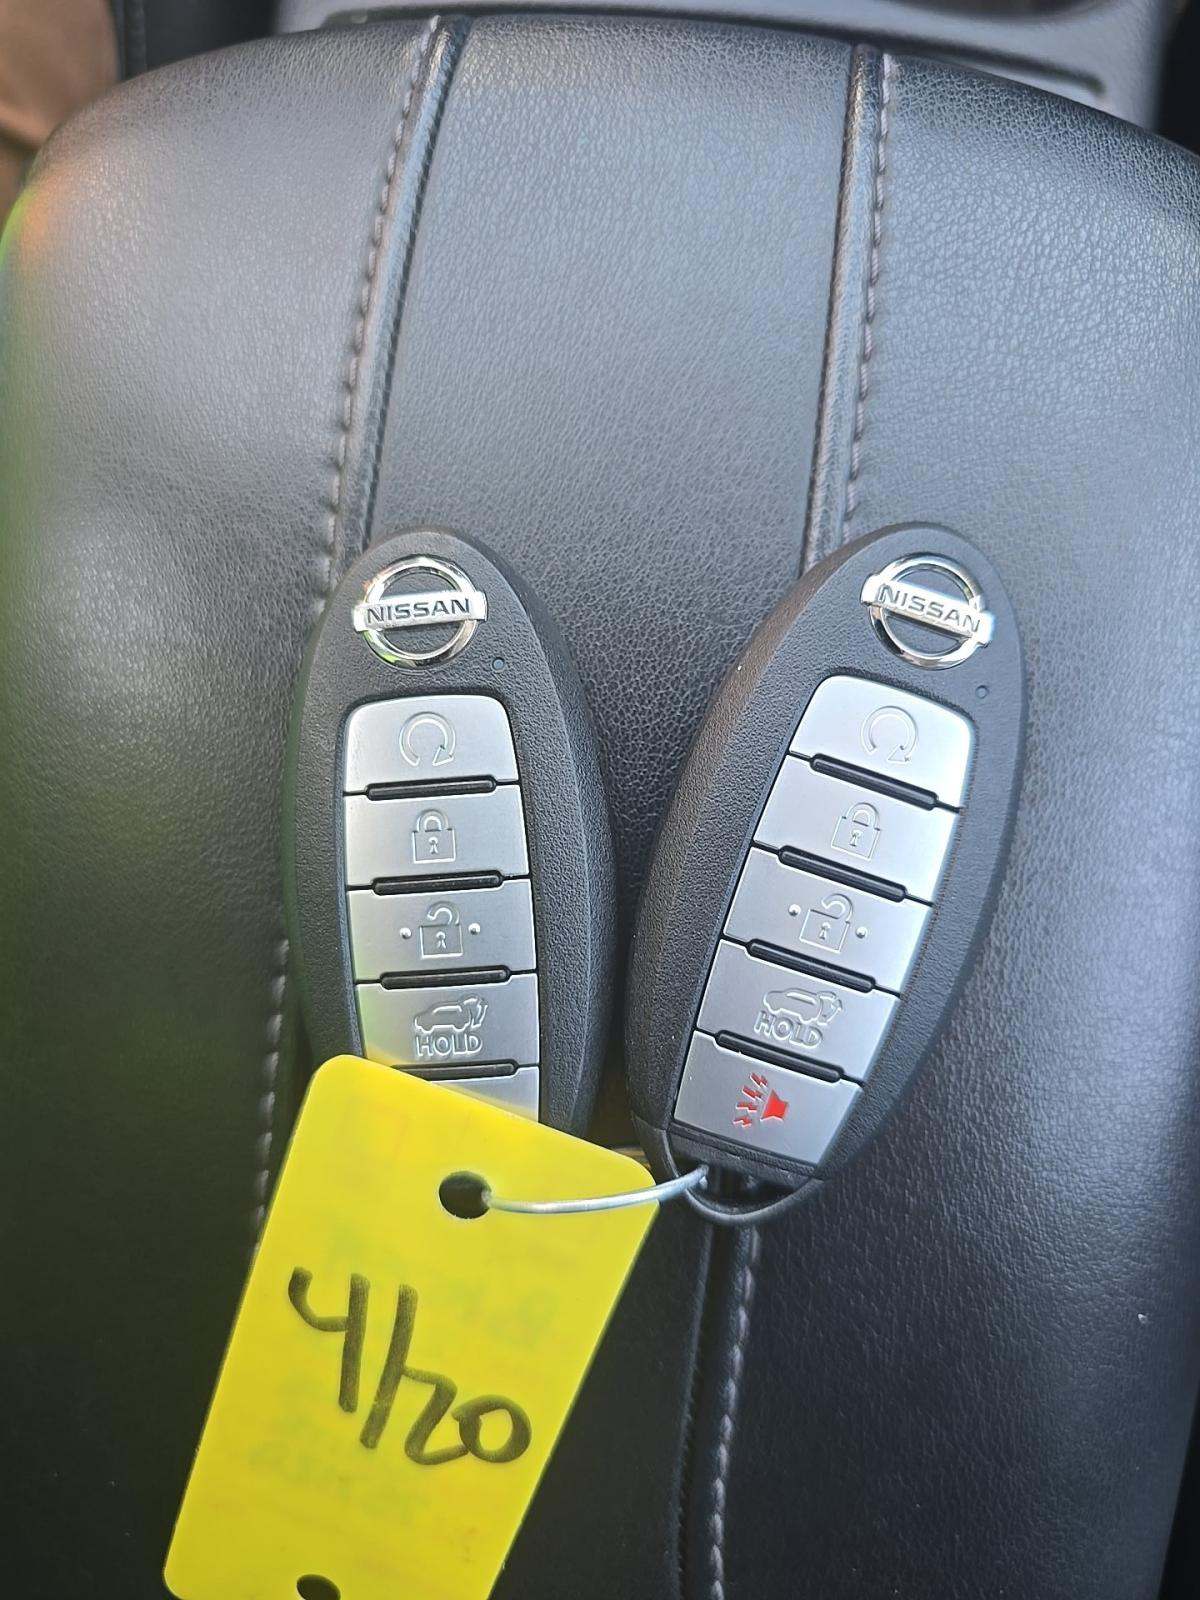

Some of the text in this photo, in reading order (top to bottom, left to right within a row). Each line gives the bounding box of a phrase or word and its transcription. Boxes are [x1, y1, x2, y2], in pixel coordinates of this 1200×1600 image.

[366, 598, 470, 624] NISSAN
[876, 582, 980, 633] NISSAN
[416, 1033, 483, 1057] HOLD
[753, 1009, 823, 1049] HOLD
